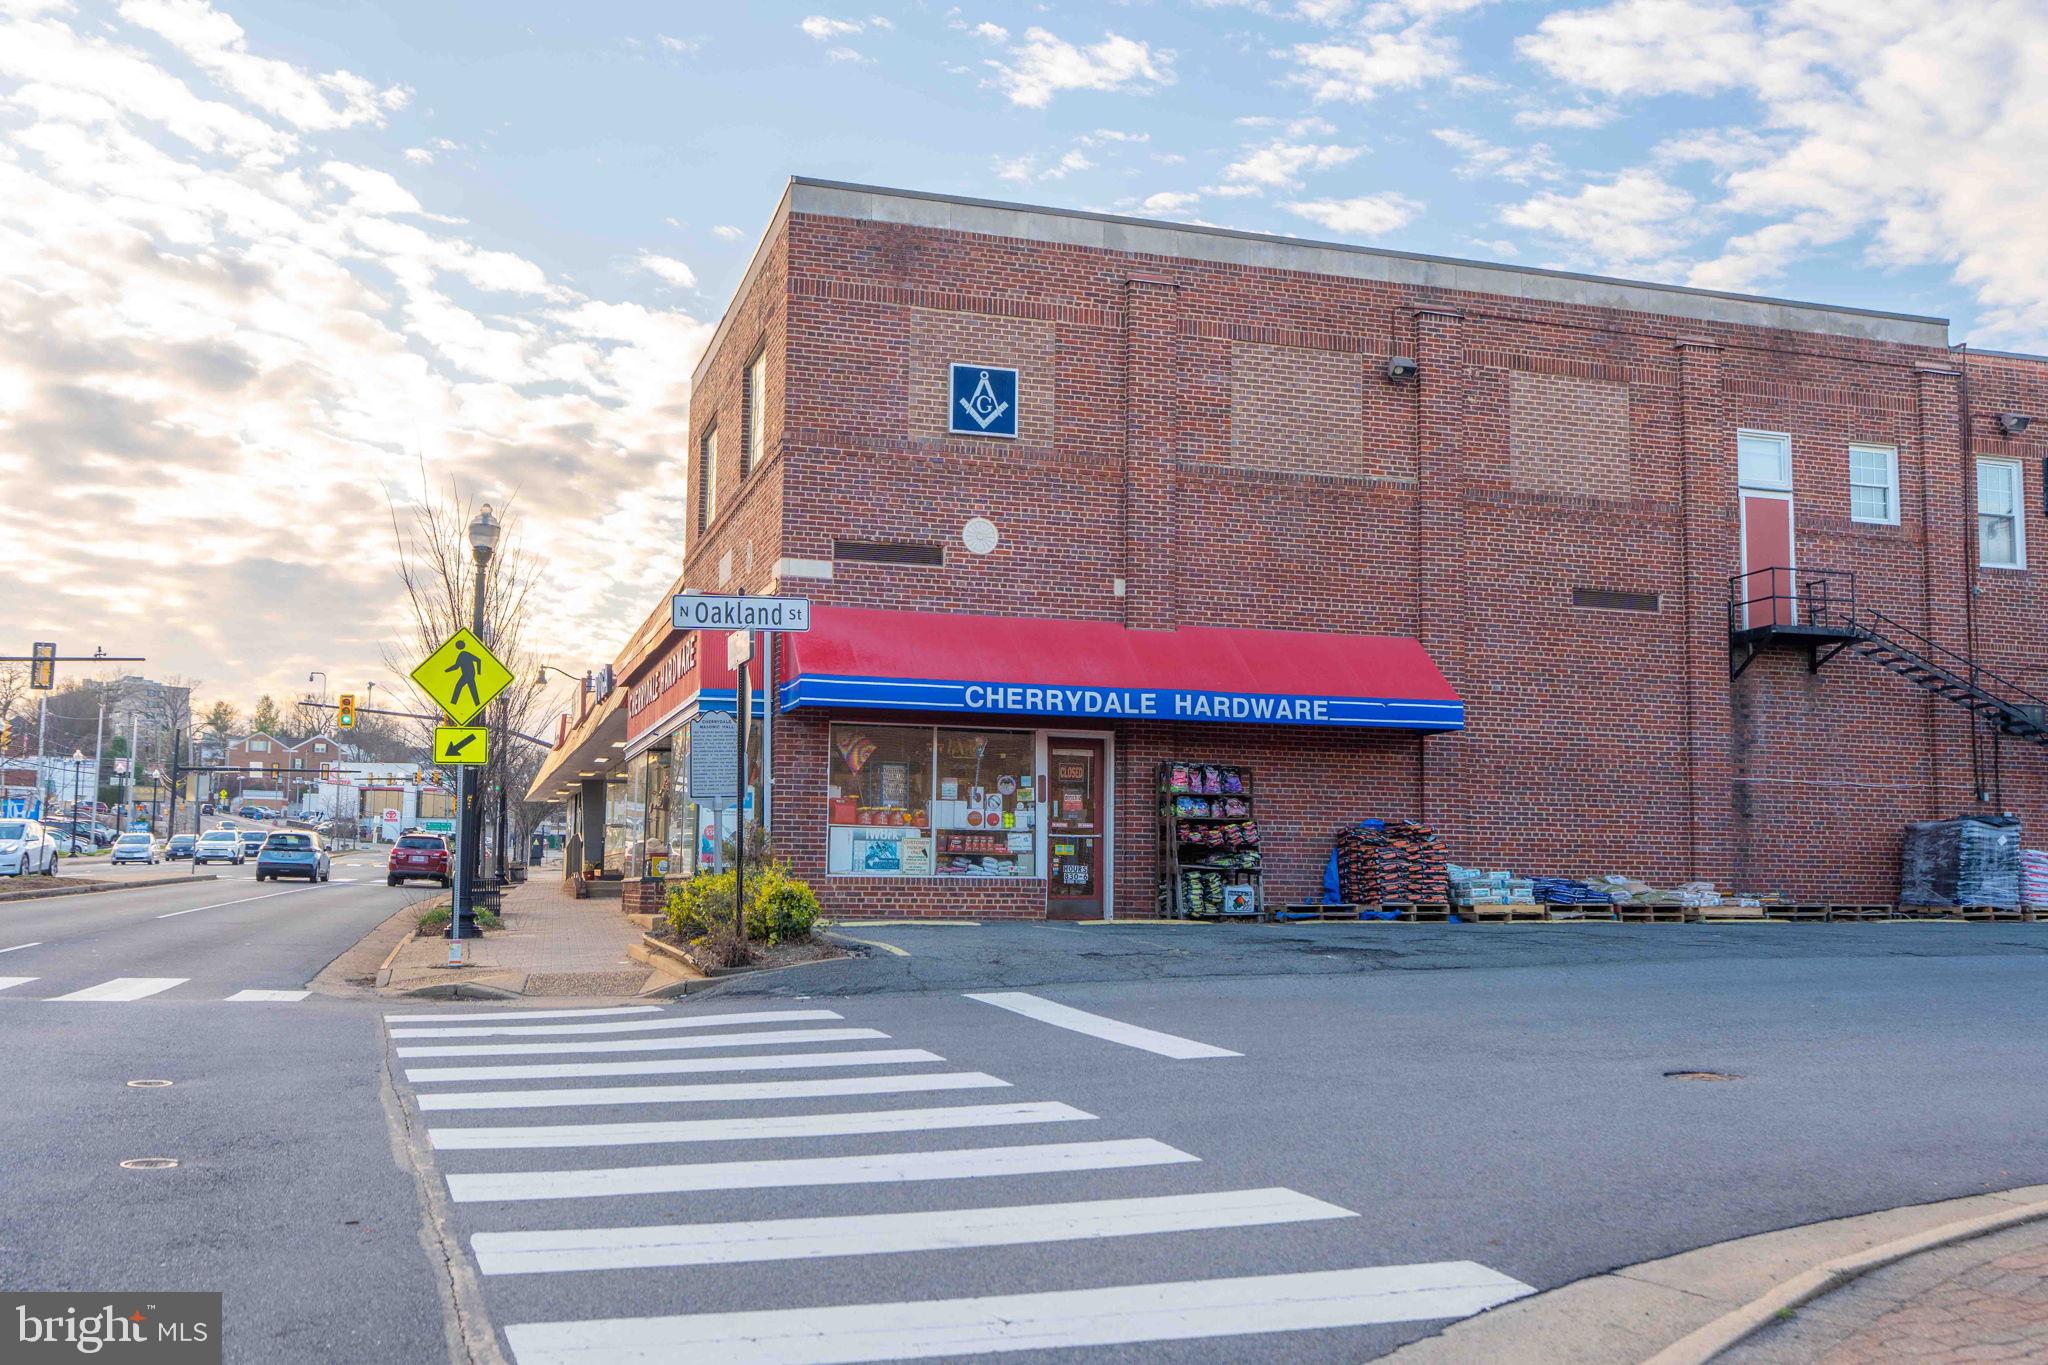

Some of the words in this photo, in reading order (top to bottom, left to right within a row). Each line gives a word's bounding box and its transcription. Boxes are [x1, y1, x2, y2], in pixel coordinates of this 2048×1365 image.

[976, 395, 993, 414] G
[680, 606, 689, 618] N
[695, 601, 782, 625] Oakland
[789, 608, 802, 620] St
[660, 635, 697, 694] HARDWARE
[965, 685, 1157, 714] CHERRYDALE
[1175, 694, 1329, 721] HARDWARE
[1060, 766, 1083, 778] CLOSED
